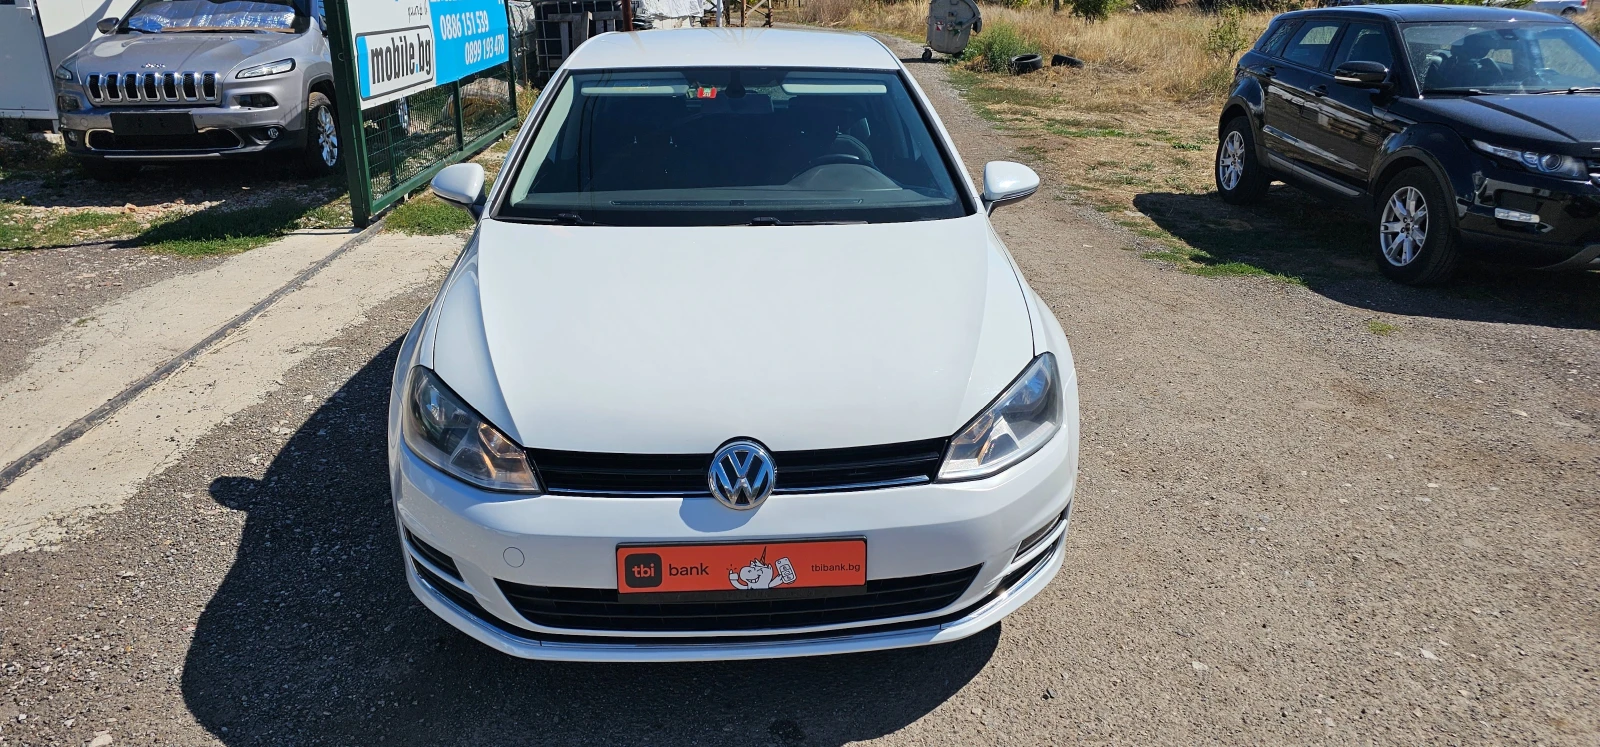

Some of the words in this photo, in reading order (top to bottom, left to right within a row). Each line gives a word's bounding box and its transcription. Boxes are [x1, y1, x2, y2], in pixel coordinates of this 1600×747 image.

[440, 14, 461, 40] 0886
[462, 12, 476, 36] 151
[476, 10, 489, 33] 539
[370, 33, 432, 84] mobile.bg
[464, 39, 481, 65] 0899
[482, 36, 494, 60] 193
[493, 34, 505, 56] 478
[631, 562, 655, 579] tbi
[668, 562, 709, 577] bank
[810, 562, 861, 574] tbibank.bg
